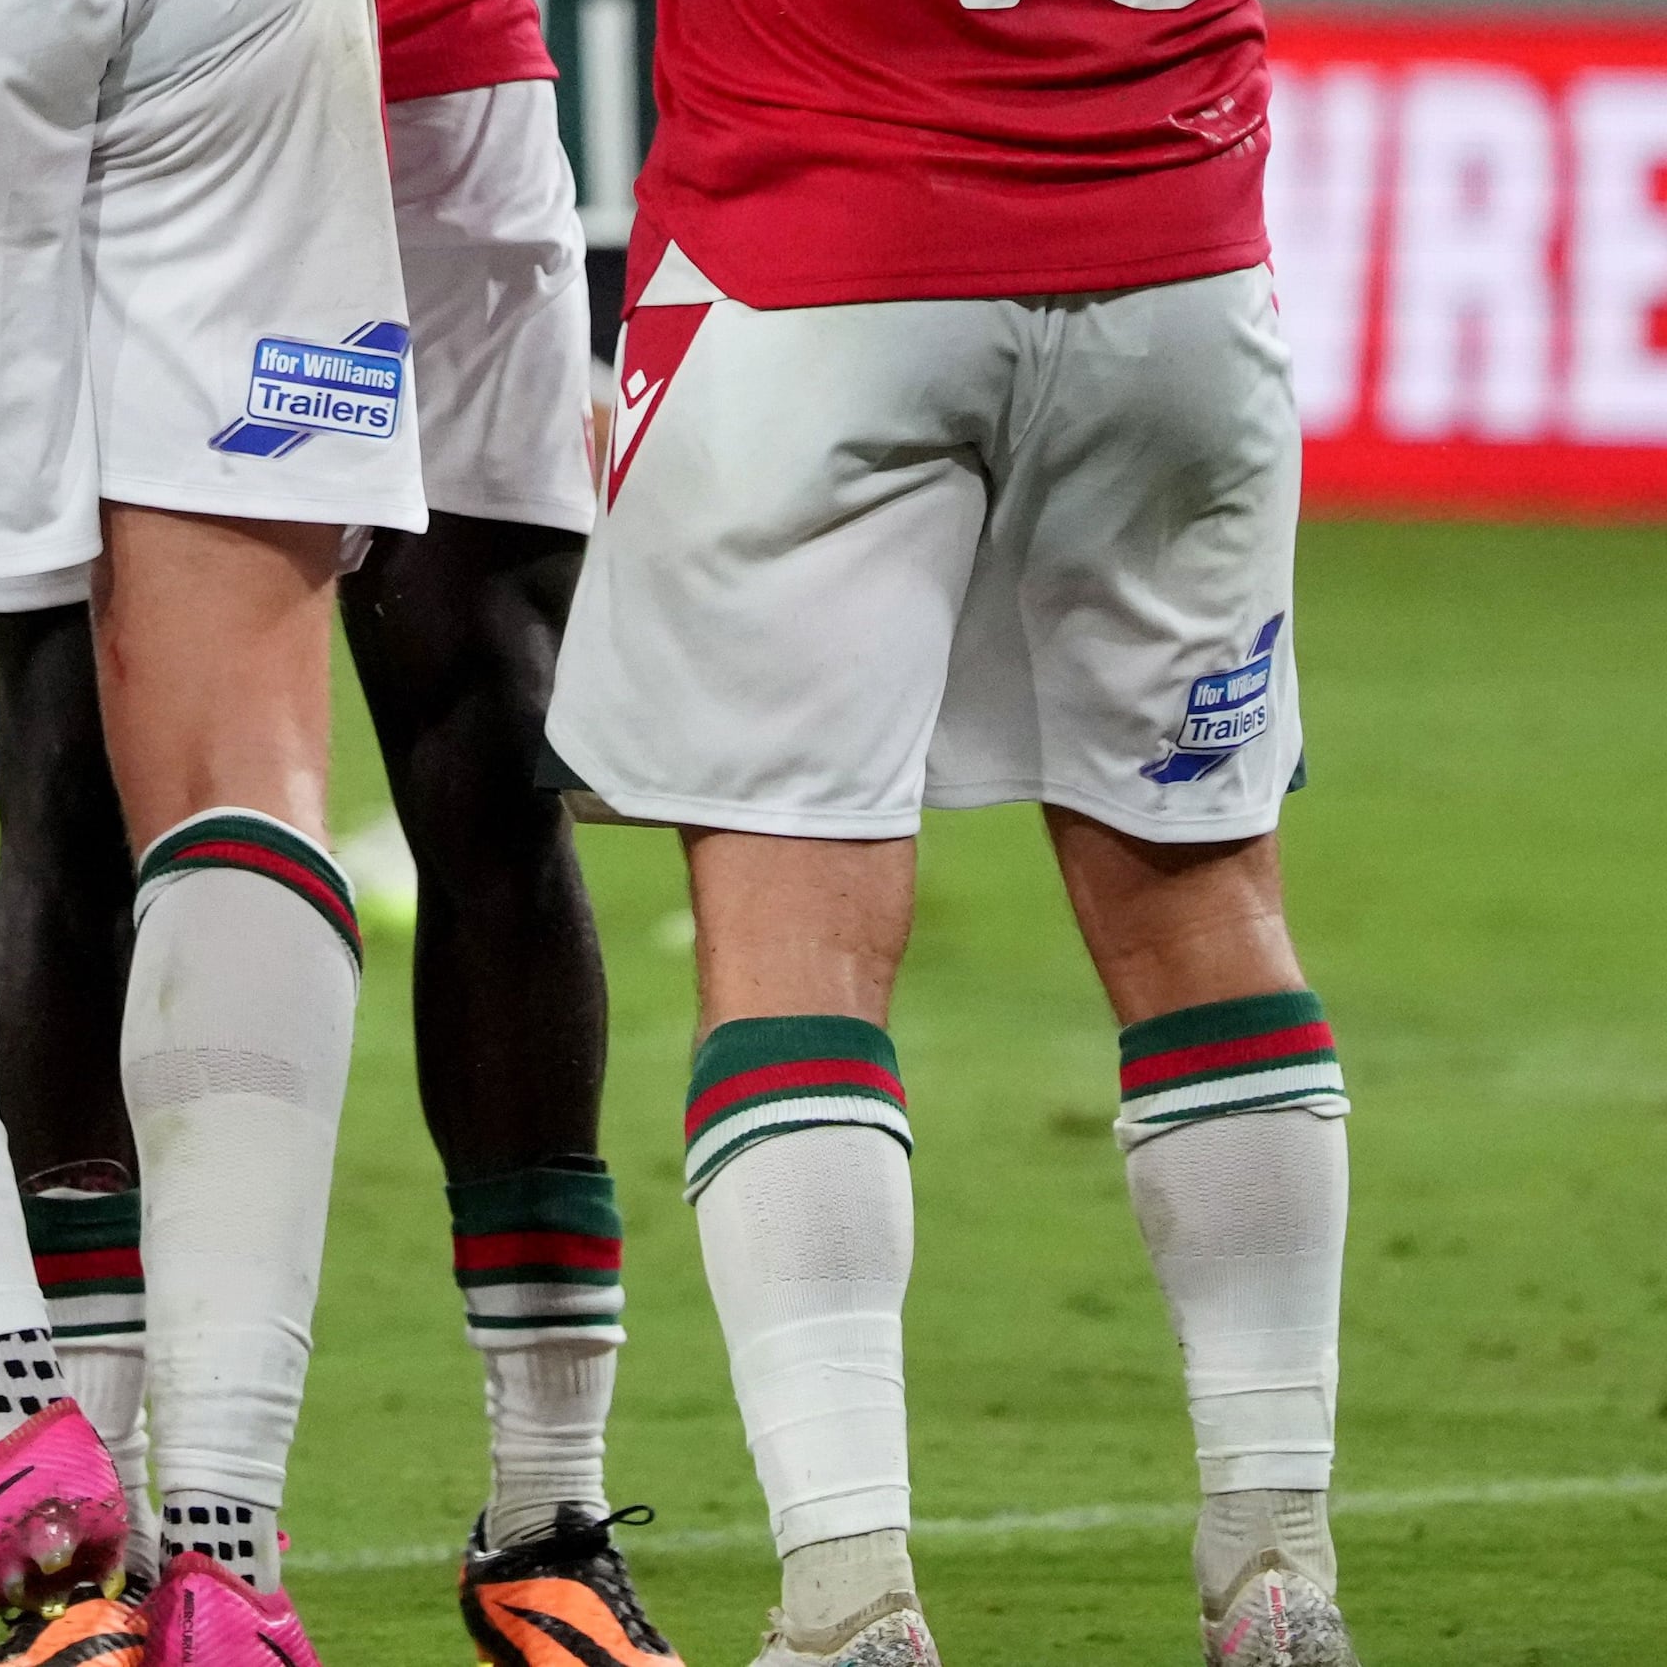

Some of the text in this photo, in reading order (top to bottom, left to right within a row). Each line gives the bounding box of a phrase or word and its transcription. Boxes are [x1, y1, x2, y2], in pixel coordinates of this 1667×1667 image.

[260, 346, 396, 390] Ifor Williams
[259, 383, 389, 428] Trailers
[1194, 684, 1224, 707] Ifor
[1190, 705, 1265, 742] Trailers
